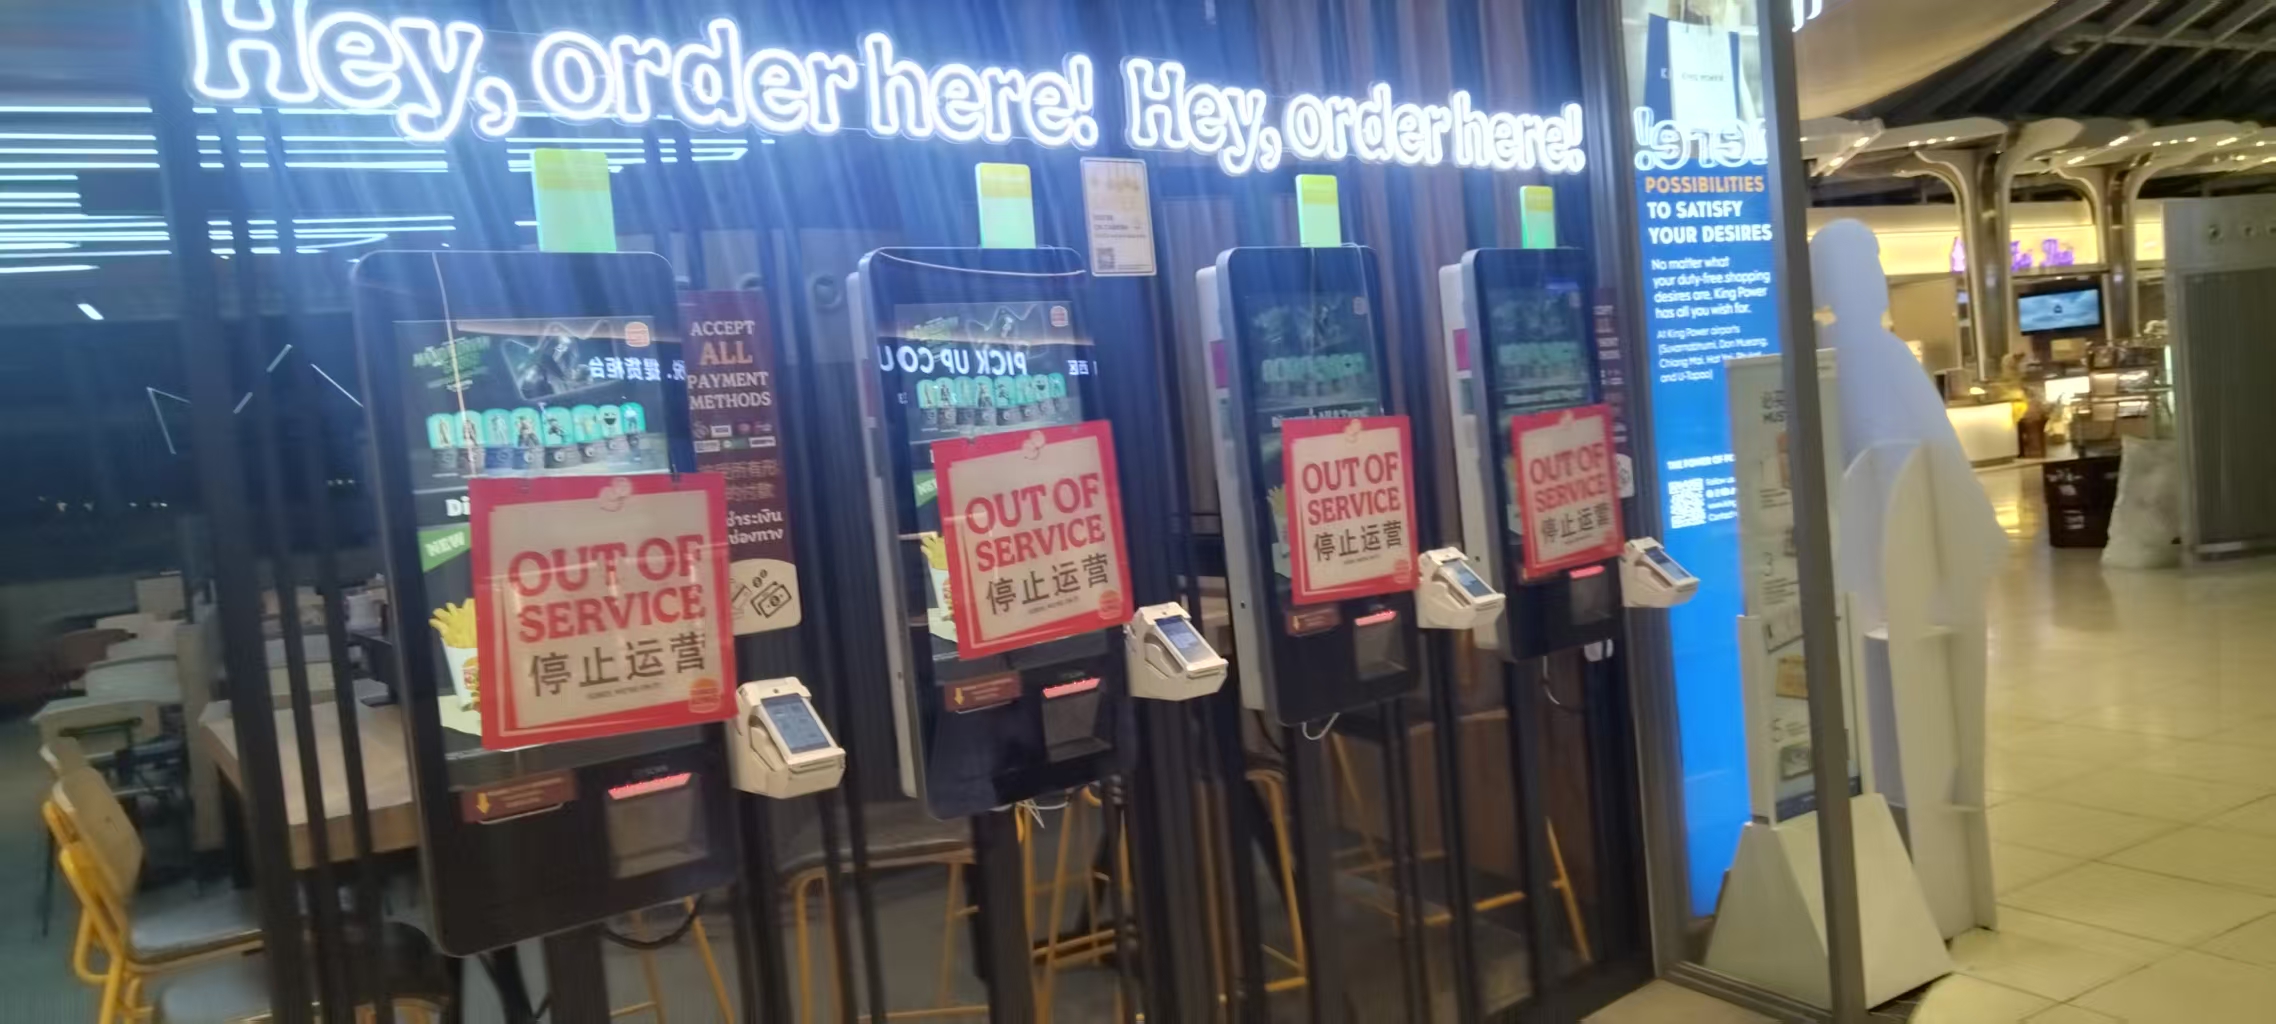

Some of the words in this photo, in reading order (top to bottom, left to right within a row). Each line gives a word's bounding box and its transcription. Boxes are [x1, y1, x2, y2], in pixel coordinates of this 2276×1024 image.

[188, 0, 517, 143] Hey,
[530, 18, 858, 134] order
[862, 32, 1100, 148] here!
[1121, 56, 1283, 174] Hey,
[1284, 82, 1451, 165] order
[1450, 90, 1587, 173] here!
[1645, 175, 1765, 194] POSSIBILITIES
[1647, 201, 1672, 219] TO
[1676, 200, 1743, 218] SATISFY
[1648, 225, 1698, 245] YOUR
[1703, 223, 1773, 243] DESIRES
[1651, 259, 1668, 271] No
[1668, 256, 1703, 269] matter
[1704, 256, 1730, 268] what
[1653, 276, 1676, 289] your
[1677, 272, 1724, 287] duty-free
[1724, 270, 1771, 285] shopping
[1654, 290, 1691, 303] desires
[1713, 287, 1737, 302] King
[1737, 286, 1768, 298] Power
[1655, 307, 1675, 319] has
[1676, 305, 1690, 318] all
[1690, 306, 1710, 320] you
[1710, 303, 1734, 315] wish
[690, 320, 755, 337] ACCEPT
[700, 340, 754, 366] ALL
[687, 371, 769, 390] PAYMENT
[689, 391, 772, 411] METHODS
[1302, 456, 1360, 494] OUT
[1364, 451, 1399, 485] OF
[1529, 448, 1573, 486] OUT
[1578, 442, 1604, 472] OF
[964, 483, 1047, 535] OUT
[1052, 472, 1099, 514] OF
[1307, 486, 1401, 526] SERVICE
[1534, 473, 1608, 514] SERVICE
[424, 531, 466, 558] NEW
[975, 514, 1106, 573] SERVICE
[1313, 519, 1402, 562] 停止运营
[508, 541, 627, 597] OUT
[636, 534, 705, 582] OF
[986, 552, 1109, 616] 停止运营
[518, 583, 706, 644] SERVICE
[528, 630, 706, 697] 停止运营
